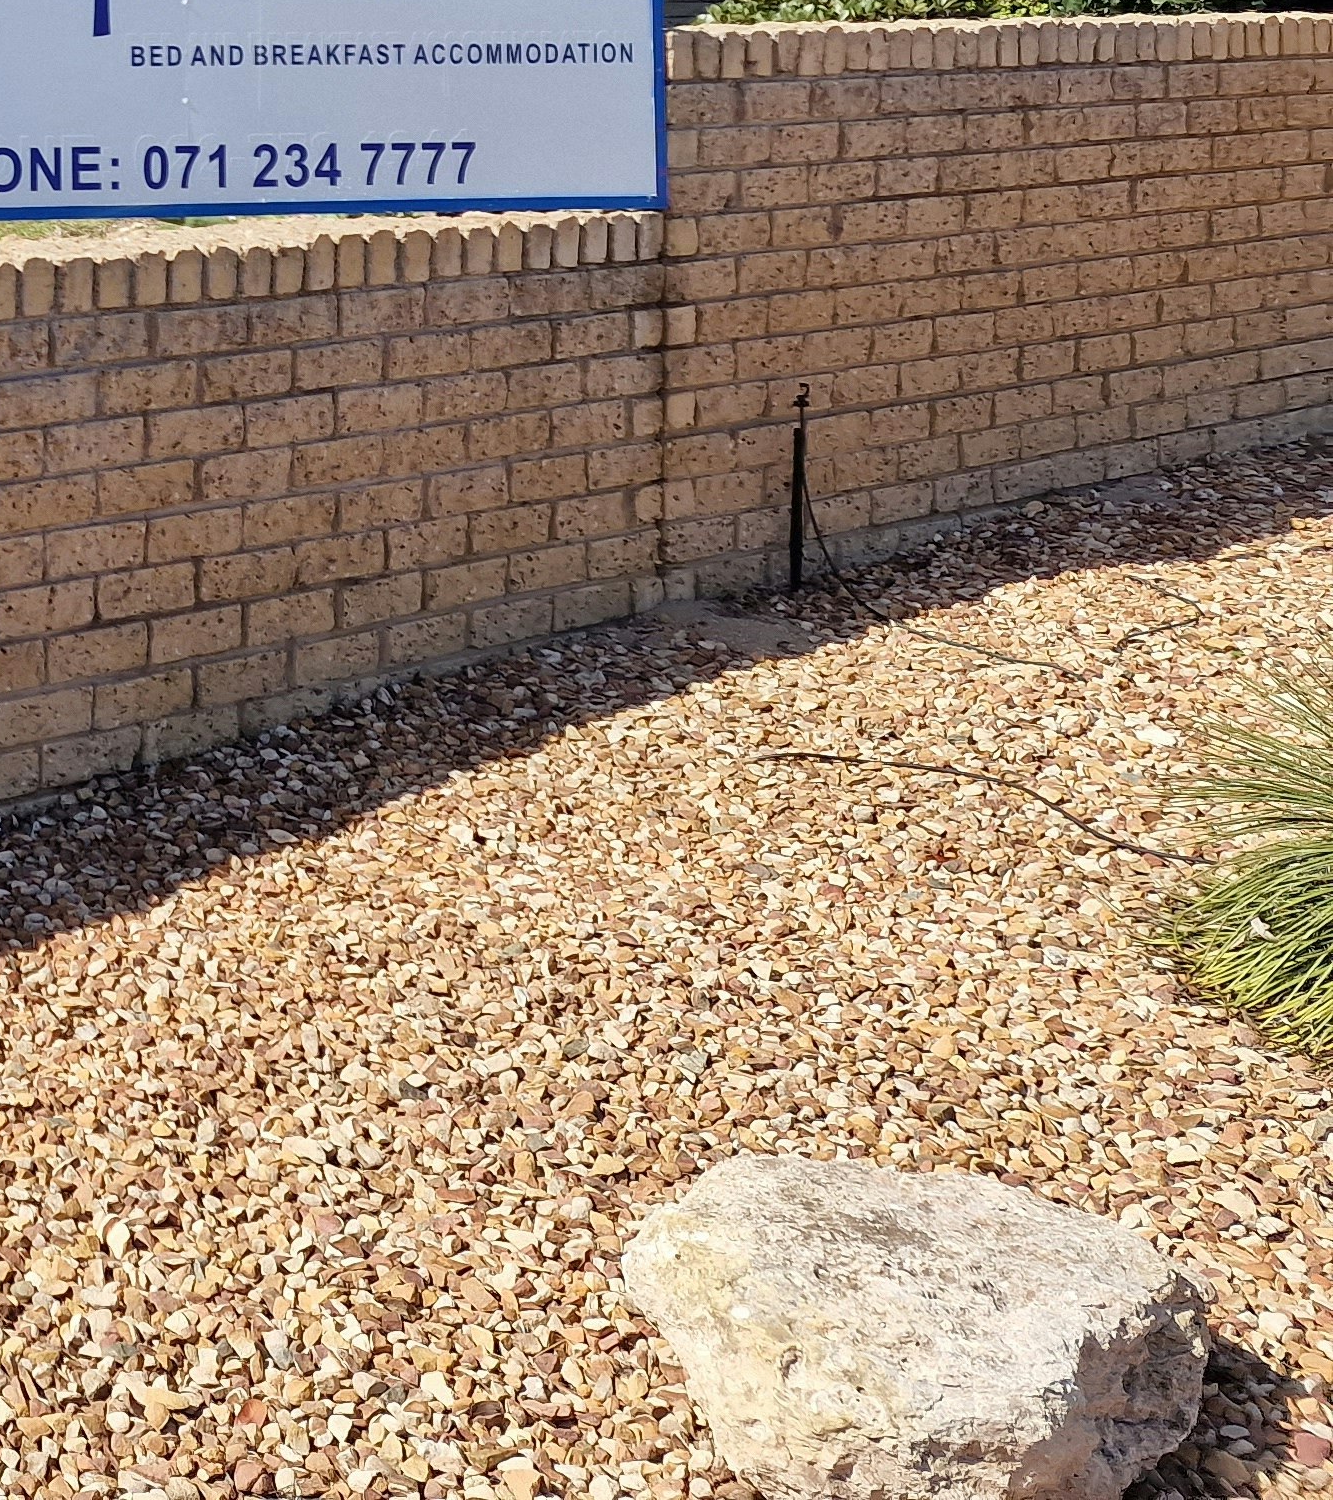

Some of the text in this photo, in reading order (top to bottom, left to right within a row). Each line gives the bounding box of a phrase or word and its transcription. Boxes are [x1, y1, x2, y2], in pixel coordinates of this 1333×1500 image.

[130, 42, 633, 67] BED AND BREAKFAST ACCOMMODATION
[143, 143, 227, 190] 071
[252, 142, 342, 188] 234
[360, 141, 476, 186] 7777
